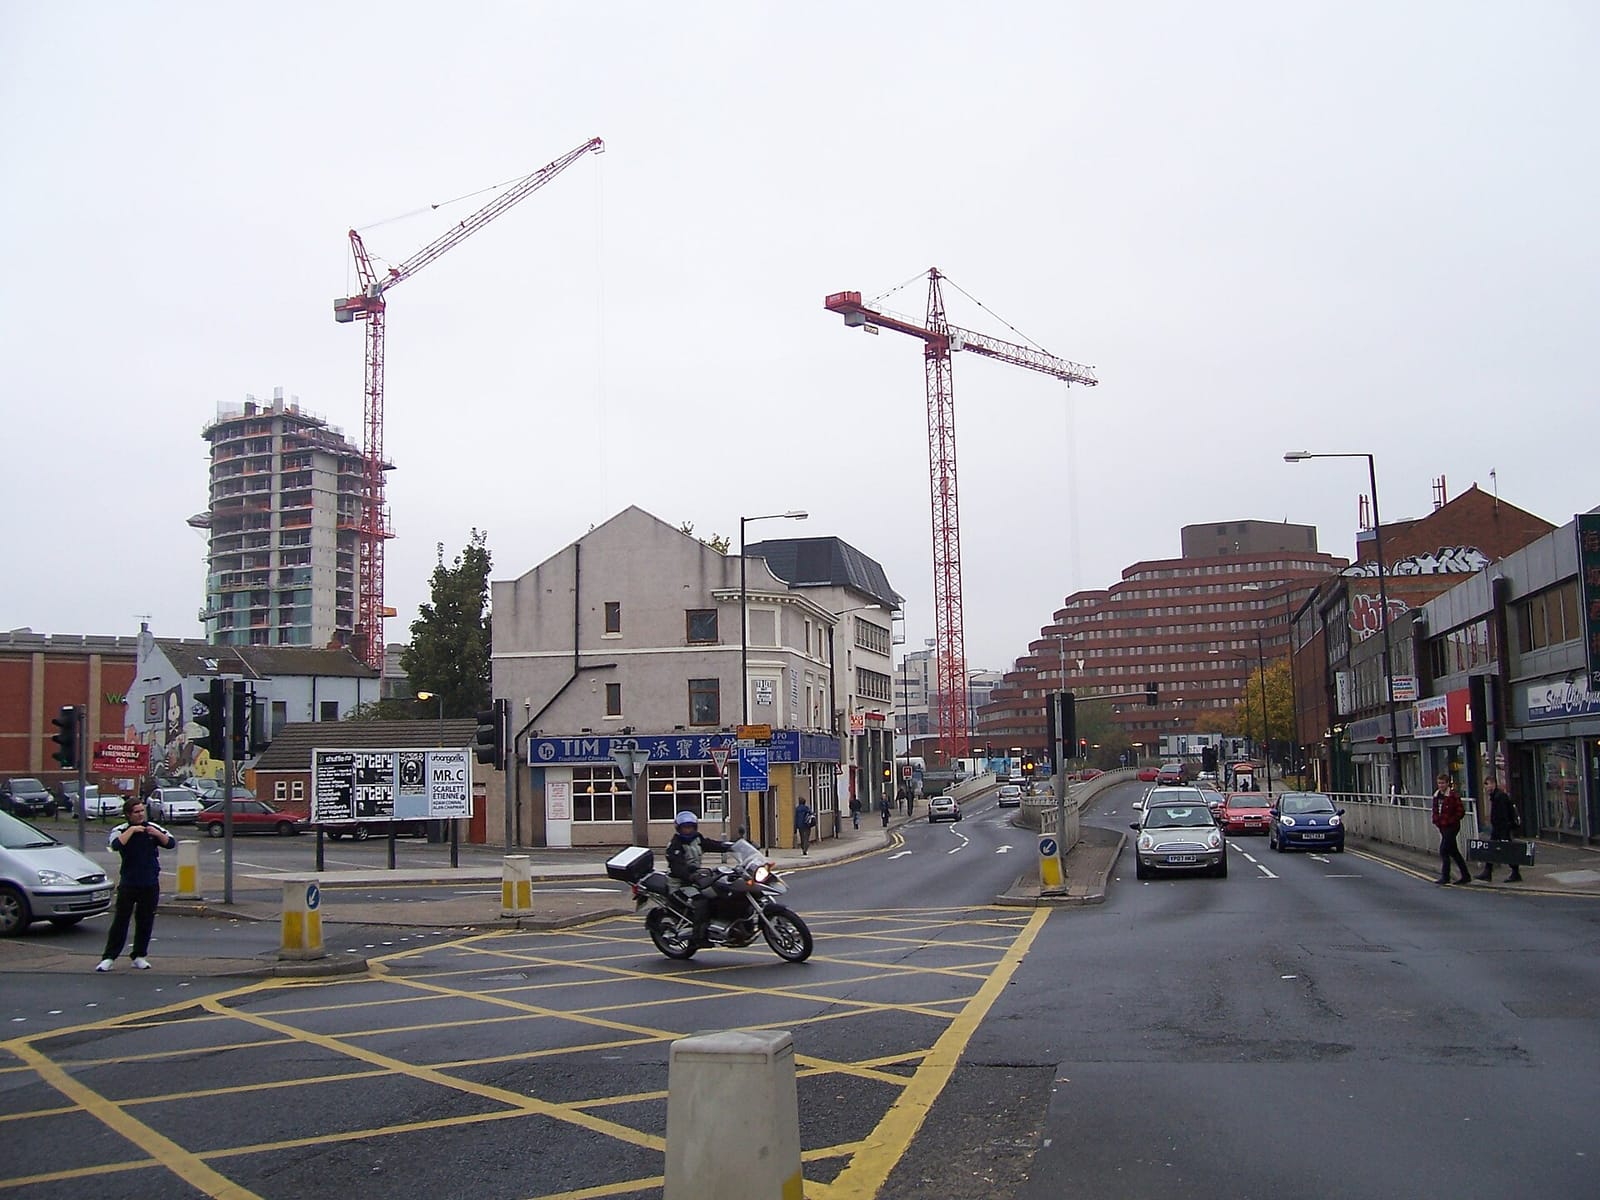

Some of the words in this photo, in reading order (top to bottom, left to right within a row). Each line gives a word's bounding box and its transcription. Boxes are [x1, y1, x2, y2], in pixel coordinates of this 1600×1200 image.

[561, 739, 599, 756] TIM
[101, 750, 140, 758] FIREWORKS
[356, 754, 393, 769] artery
[433, 769, 455, 781] MR.
[456, 769, 464, 781] C
[356, 786, 393, 801] artery
[432, 785, 464, 793] SCARLETT
[432, 792, 459, 800] ETIENNE
